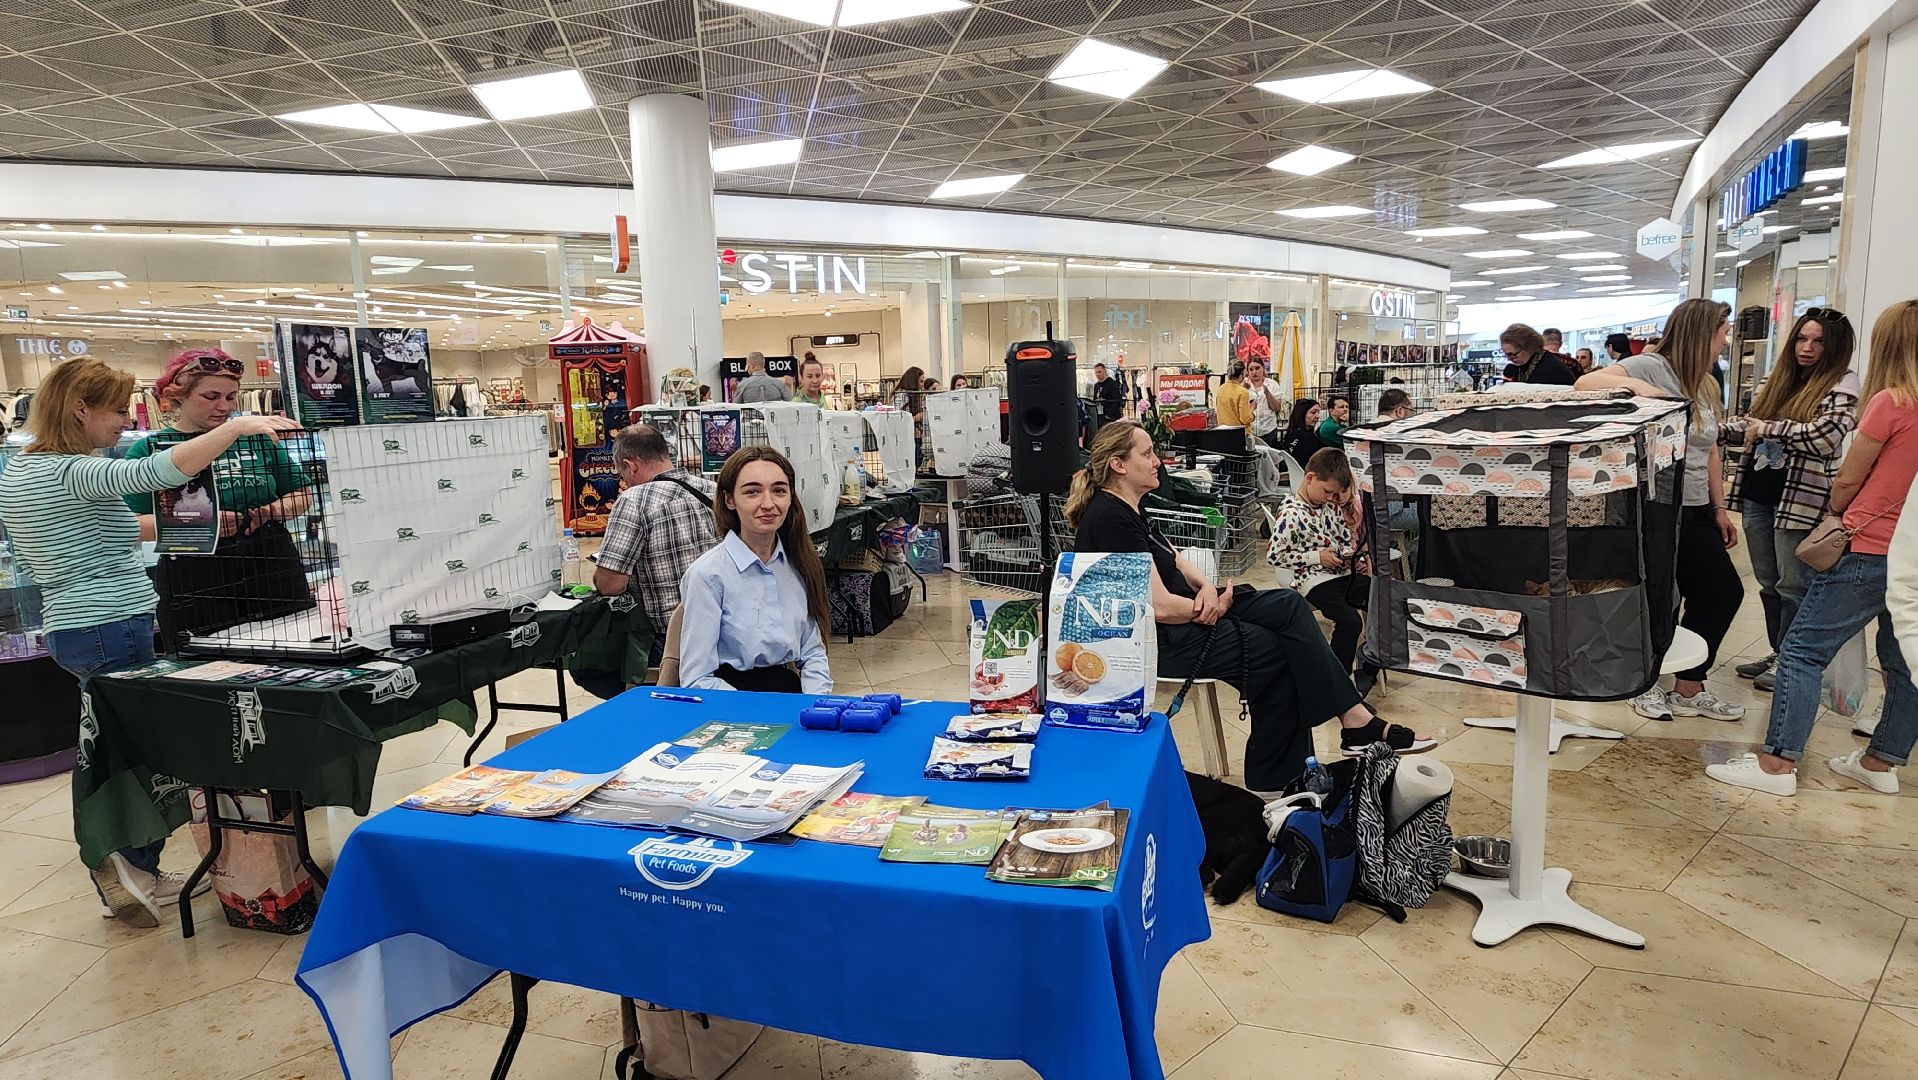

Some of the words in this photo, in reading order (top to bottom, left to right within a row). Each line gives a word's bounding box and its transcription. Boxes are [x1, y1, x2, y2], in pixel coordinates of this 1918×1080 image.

[1641, 234, 1677, 246] befree
[730, 362, 748, 373] BLA
[769, 360, 791, 371] BOX
[1160, 380, 1173, 388] МЫ
[579, 462, 618, 478] CIRCU
[1074, 595, 1137, 628] N&D
[993, 629, 1034, 650] N&D
[642, 843, 731, 863] Farmina
[648, 856, 666, 869] Pet
[667, 859, 698, 875] Foods
[619, 886, 649, 903] Happy
[652, 894, 669, 905] pet.
[672, 895, 703, 911] Happy
[705, 902, 726, 914] you.
